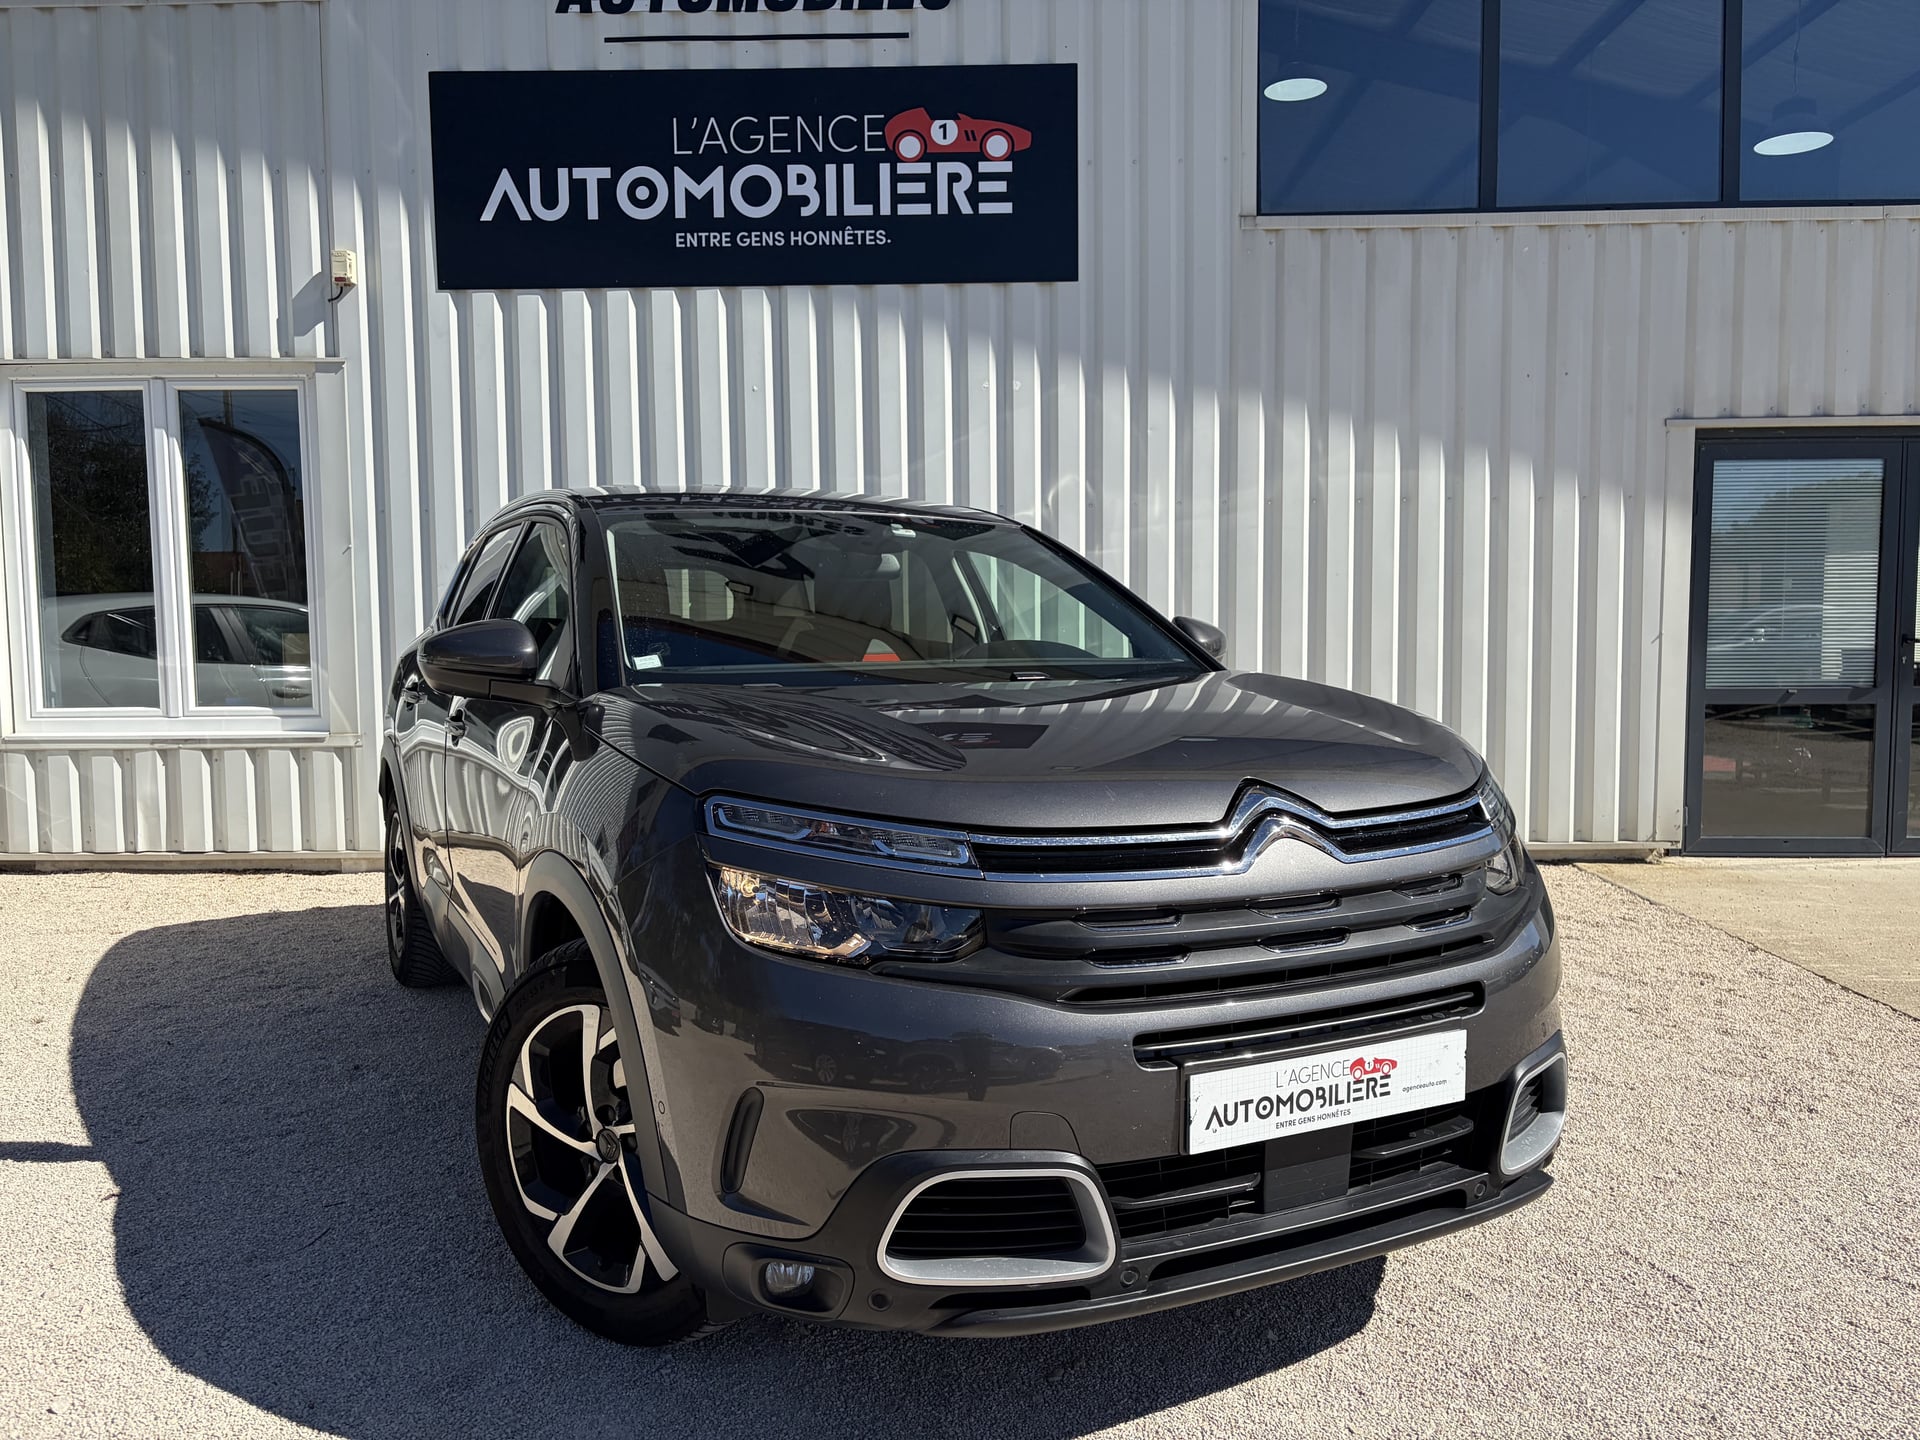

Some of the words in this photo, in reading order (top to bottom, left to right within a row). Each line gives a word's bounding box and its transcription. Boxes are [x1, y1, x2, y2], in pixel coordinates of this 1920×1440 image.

[672, 113, 887, 155] L'AGENCE
[937, 122, 948, 140] 1
[480, 160, 1014, 222] AUTOMOBILIERE
[675, 230, 732, 248] ENTRE
[736, 230, 786, 248] GENS
[789, 225, 892, 247] HONNÊTES.
[1275, 1059, 1352, 1089] L'AGENCE
[1402, 1079, 1448, 1094] agenceauto.com
[1204, 1074, 1392, 1131] AUTOMOBILIERE
[1275, 1119, 1297, 1130] ENTRE
[1297, 1115, 1317, 1126] GENS
